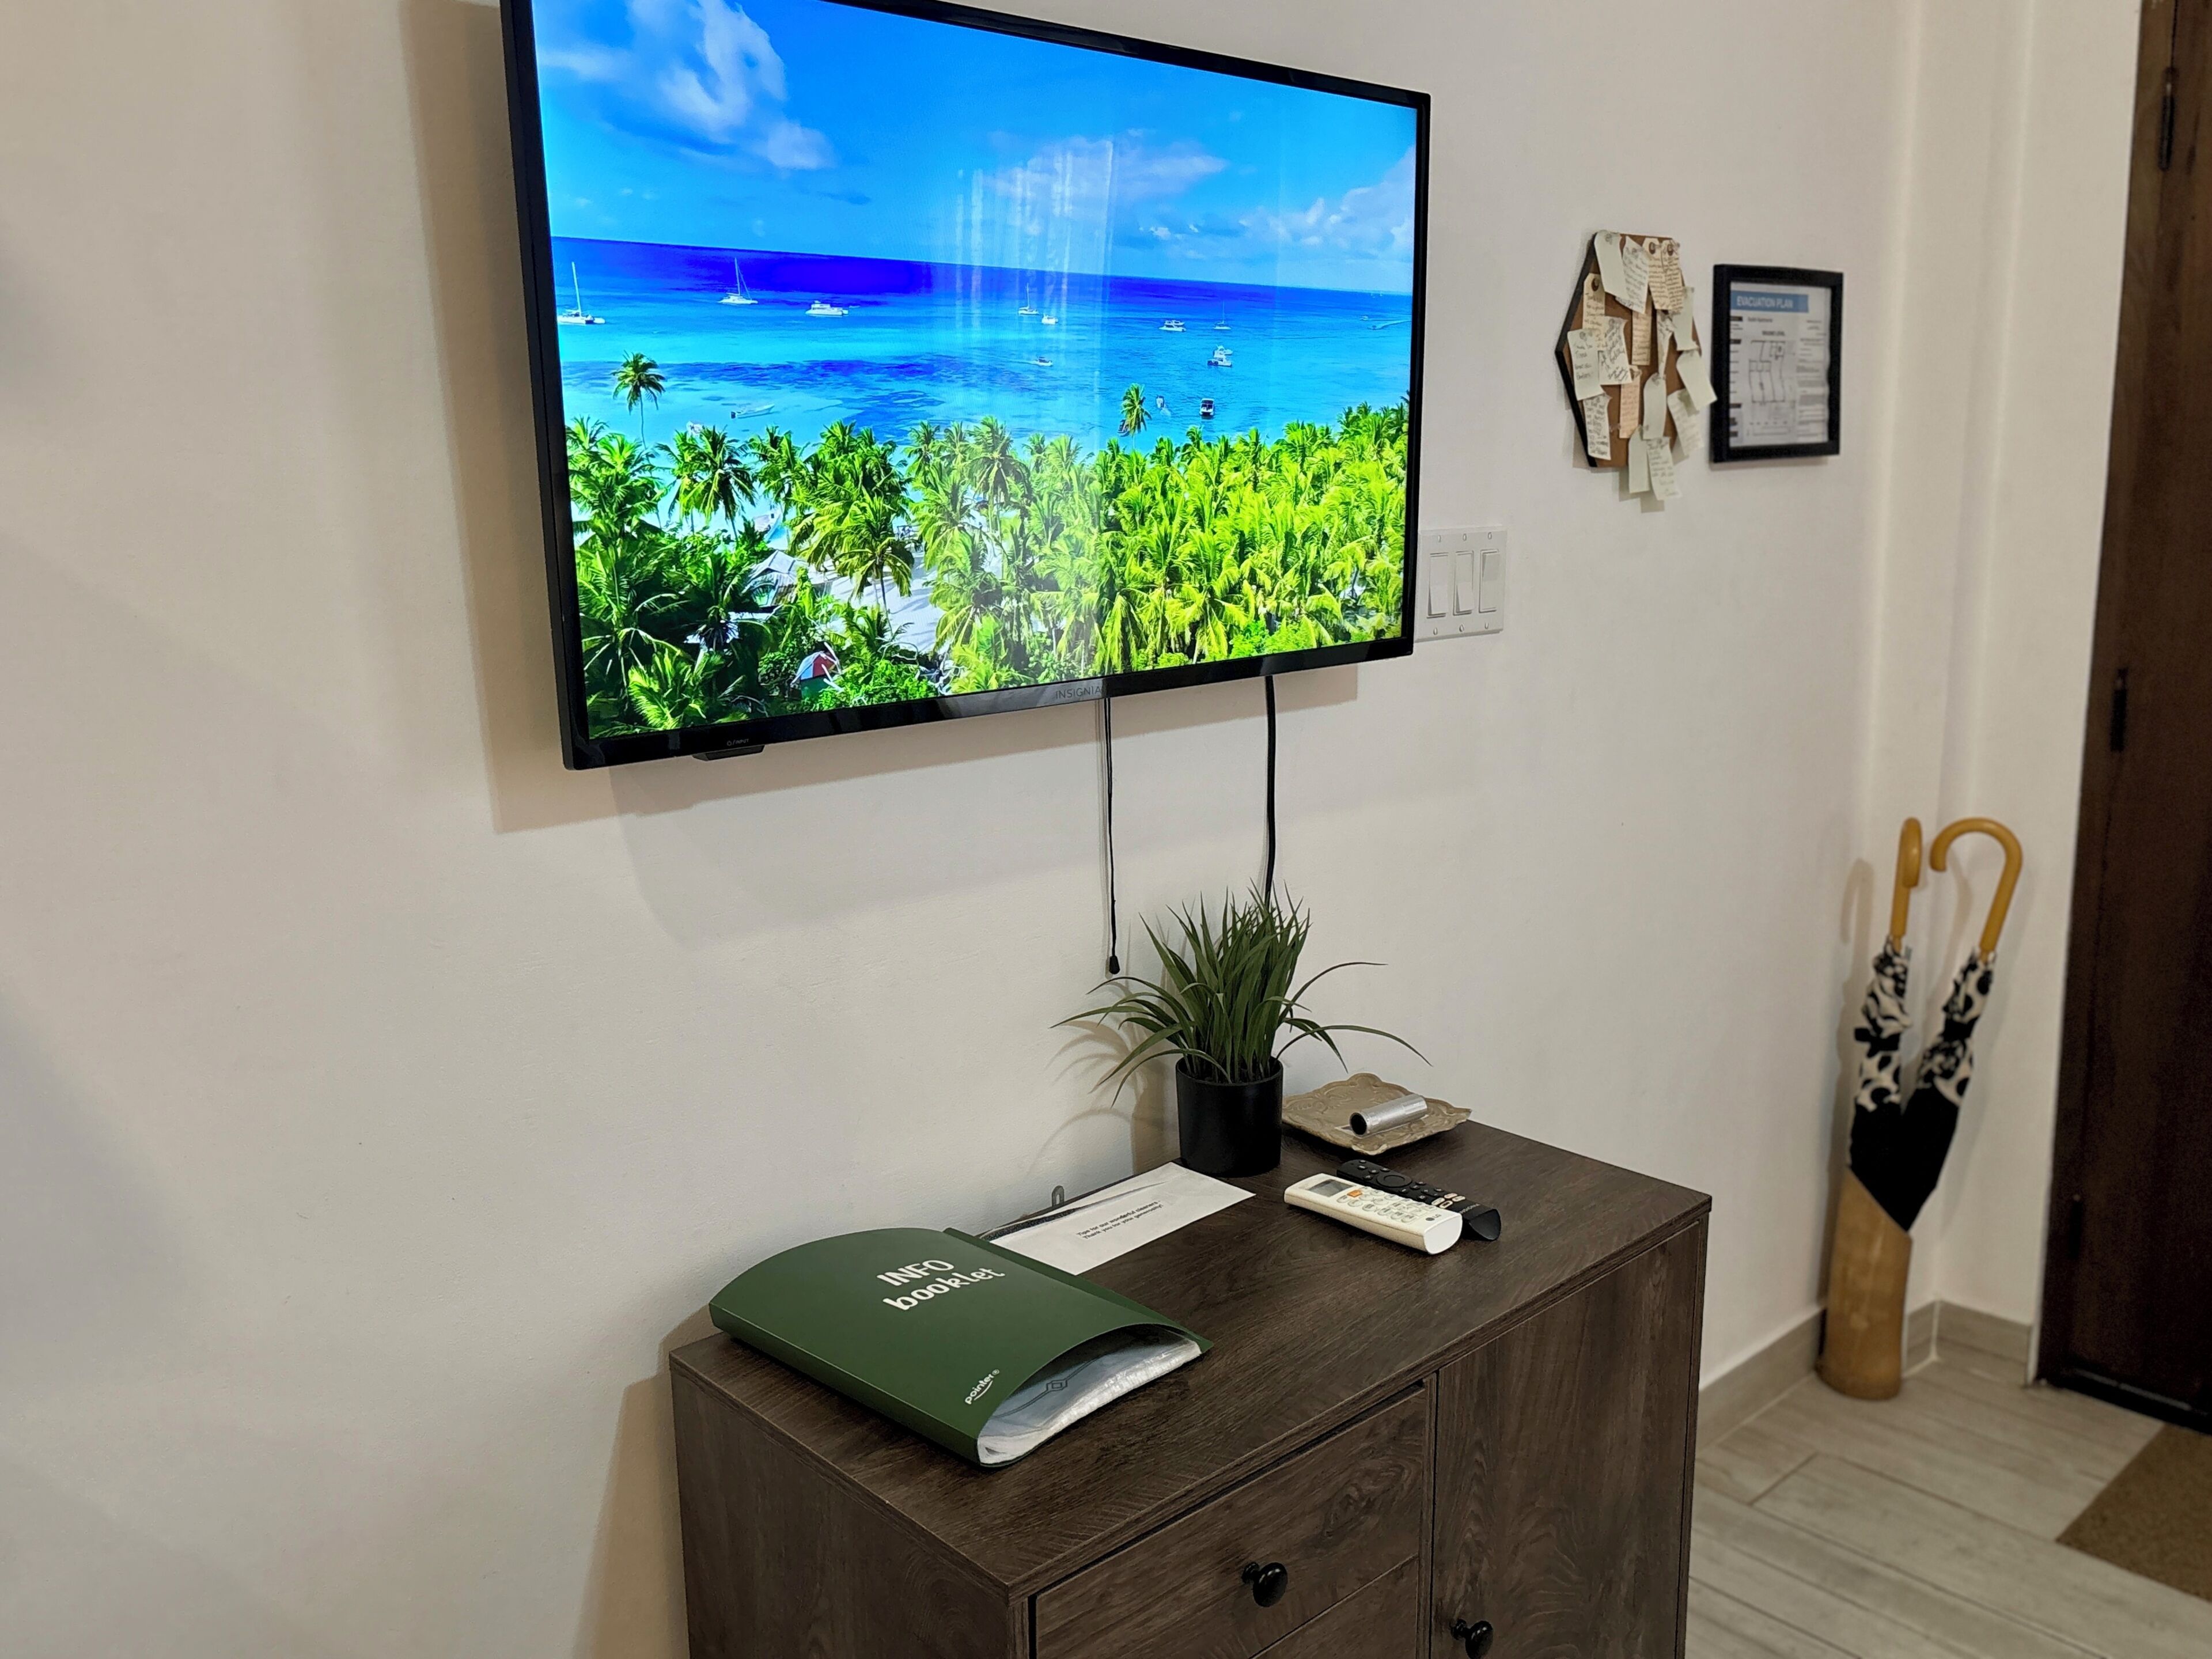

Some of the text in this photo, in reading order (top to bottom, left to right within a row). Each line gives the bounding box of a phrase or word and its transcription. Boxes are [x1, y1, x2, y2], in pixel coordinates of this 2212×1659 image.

[1737, 296, 1793, 309] EVACUATION PLAN
[1055, 686, 1101, 699] INSIGNIA
[1109, 1210, 1136, 1223] wonderful
[1135, 1202, 1158, 1212] cleaners
[1082, 1230, 1102, 1239] Thank
[876, 1259, 955, 1286] INFO
[882, 1268, 1006, 1310] booklet
